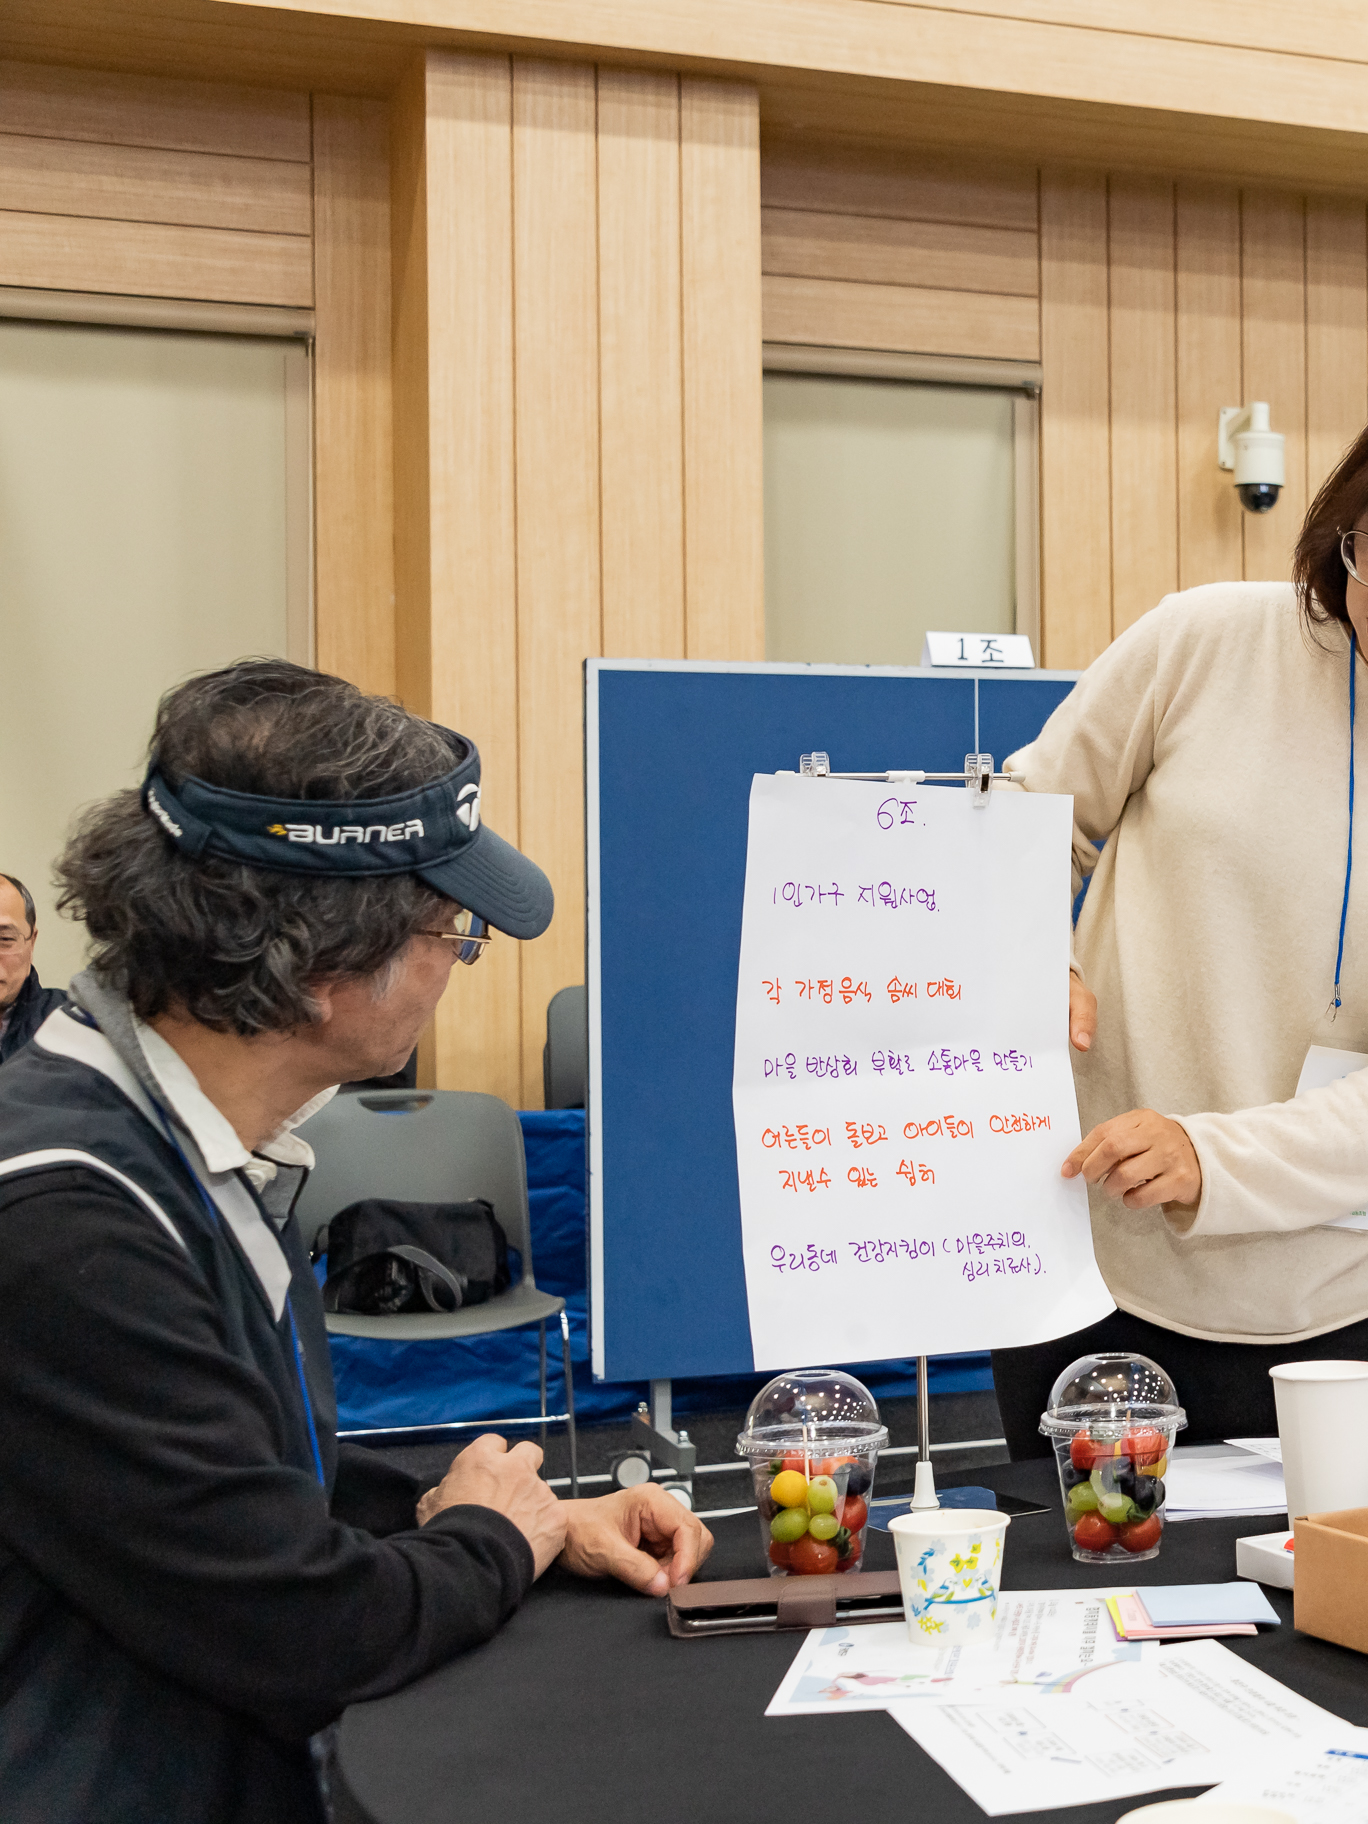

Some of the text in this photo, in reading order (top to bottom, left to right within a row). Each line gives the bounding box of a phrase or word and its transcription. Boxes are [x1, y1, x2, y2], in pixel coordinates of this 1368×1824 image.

[284, 818, 425, 845] BURNER
[761, 977, 783, 1005] 각
[926, 977, 962, 1001] 대회
[764, 1052, 797, 1080] 마을
[993, 1049, 1033, 1072] 만들기
[761, 1112, 1051, 1151] 어른들이 돌보고 아이들이 안전하게
[846, 1166, 878, 1188] 있는
[770, 1243, 838, 1273] 우리동네
